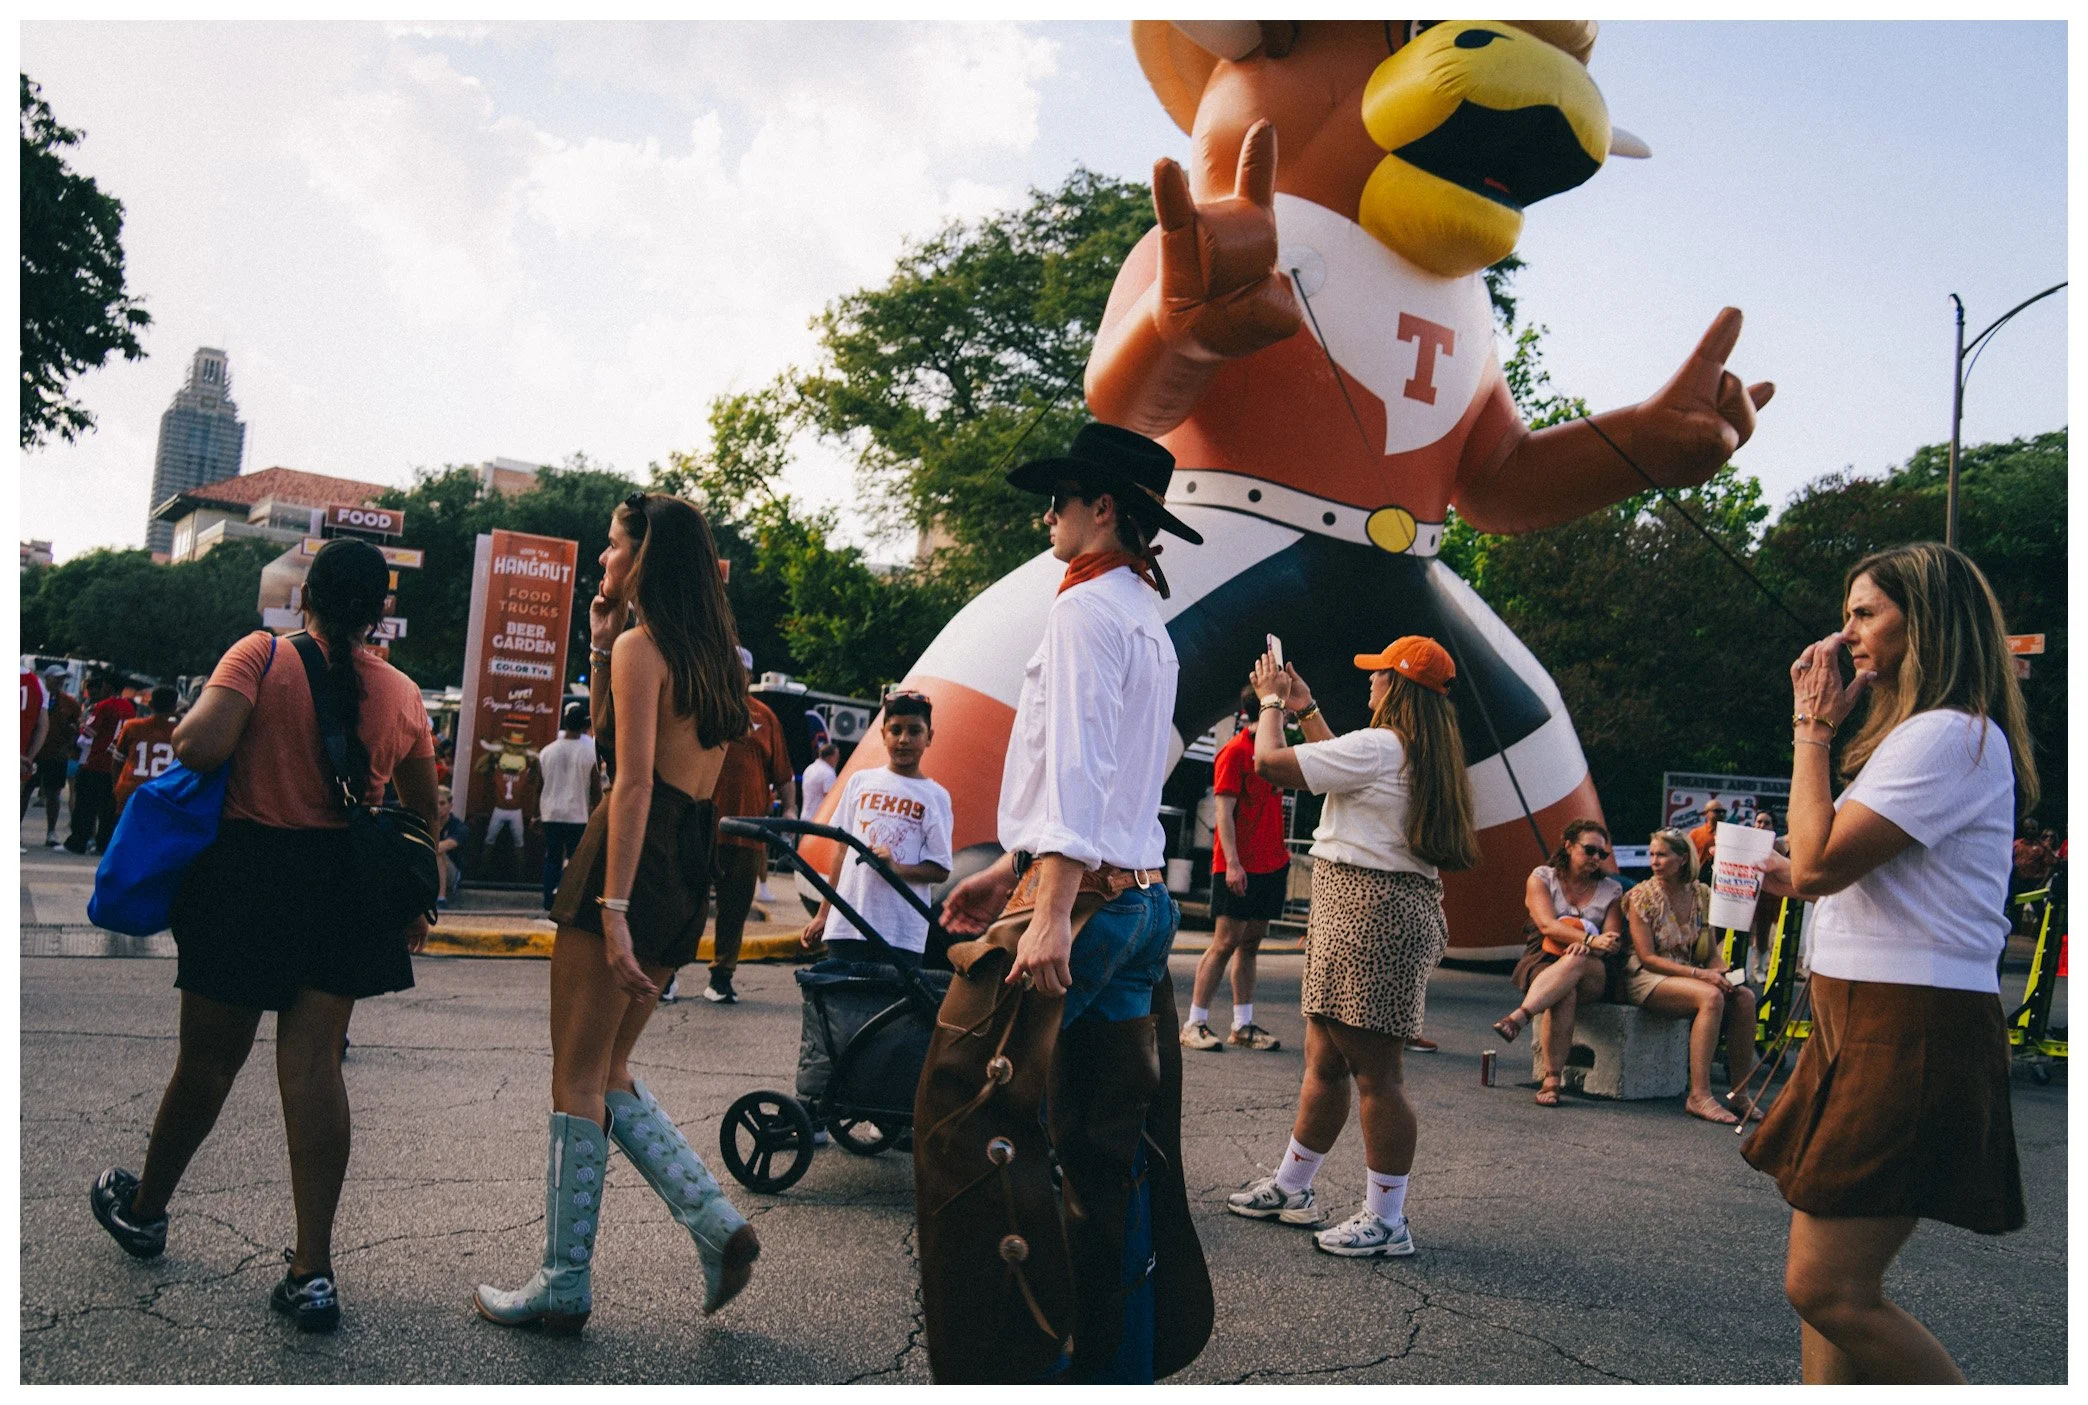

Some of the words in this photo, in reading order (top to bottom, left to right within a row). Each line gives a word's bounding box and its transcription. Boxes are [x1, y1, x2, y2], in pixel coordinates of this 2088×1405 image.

[1397, 311, 1455, 406] T
[338, 508, 392, 529] FOOD
[493, 556, 571, 584] HANGOUT
[508, 587, 551, 603] FOOD
[499, 600, 560, 618] TRUCKS
[506, 621, 547, 639] BEER
[492, 634, 556, 655] GARDEN
[495, 663, 529, 673] COLOR
[133, 740, 175, 778] 12
[505, 781, 514, 800] 1
[860, 792, 925, 820] TEXAS
